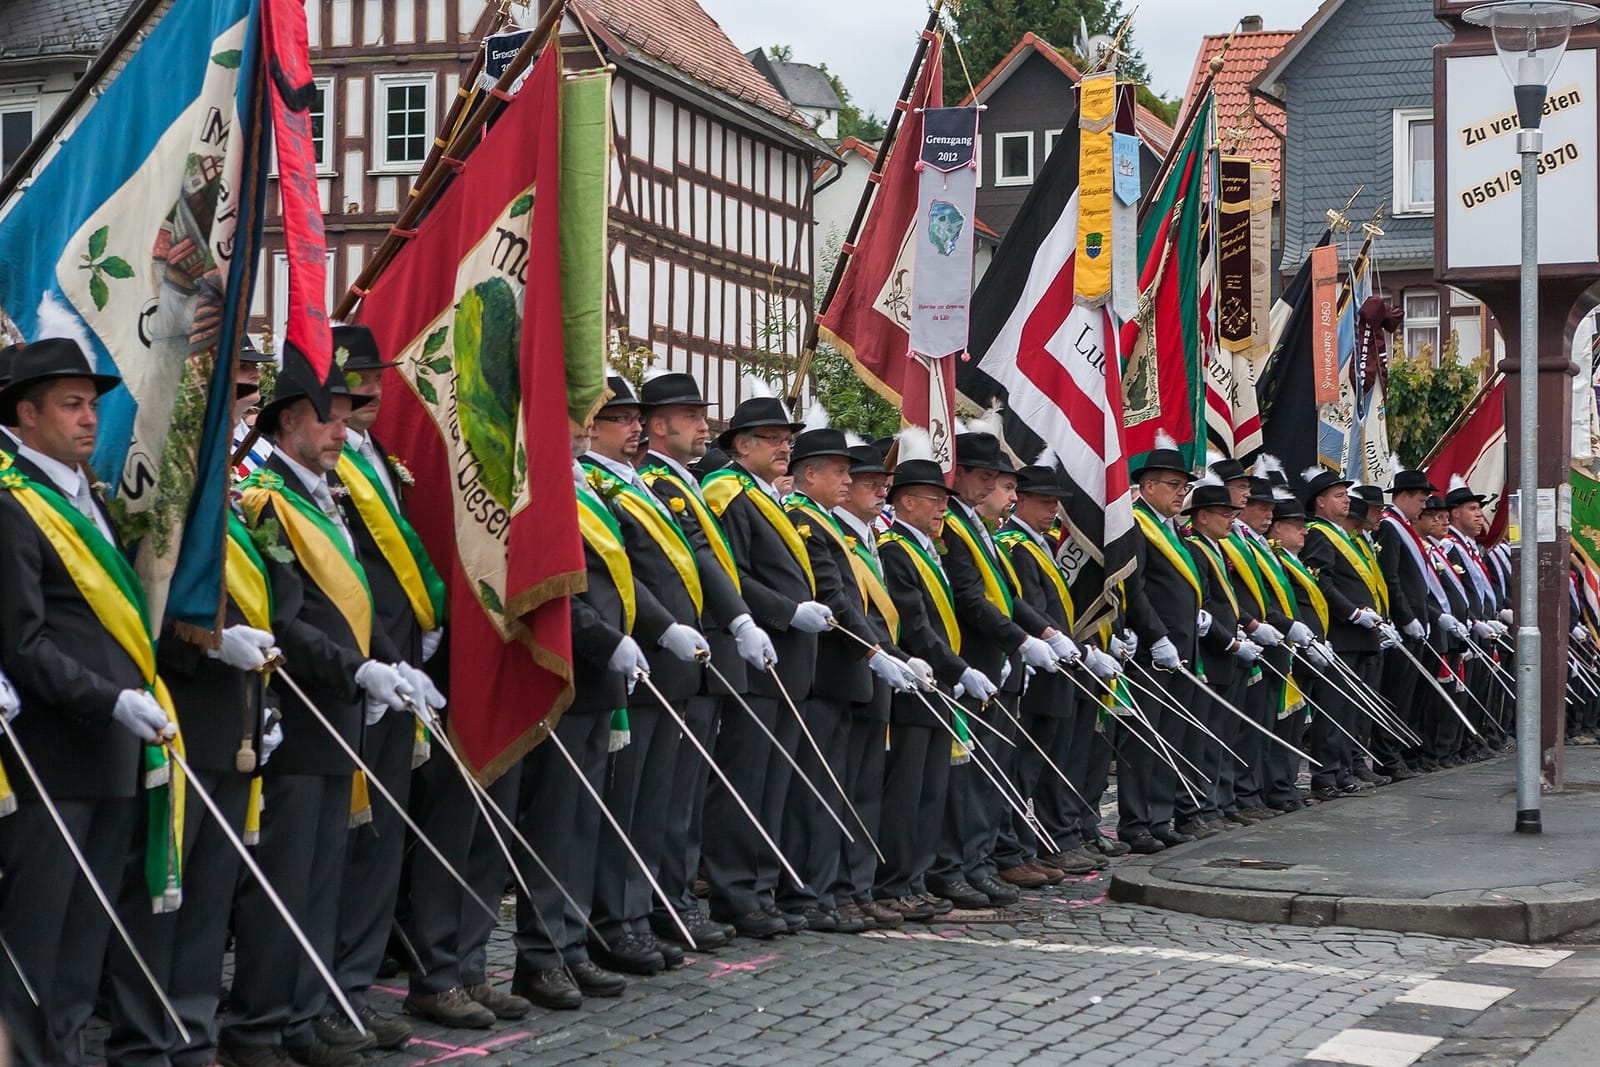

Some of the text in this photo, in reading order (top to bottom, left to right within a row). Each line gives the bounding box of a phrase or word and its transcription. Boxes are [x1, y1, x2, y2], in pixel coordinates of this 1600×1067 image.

[925, 134, 973, 147] Grenzgang
[1462, 127, 1487, 146] Zu
[937, 151, 959, 162] 2012
[1461, 142, 1579, 209] 0561/98970
[1321, 301, 1332, 326] 1950
